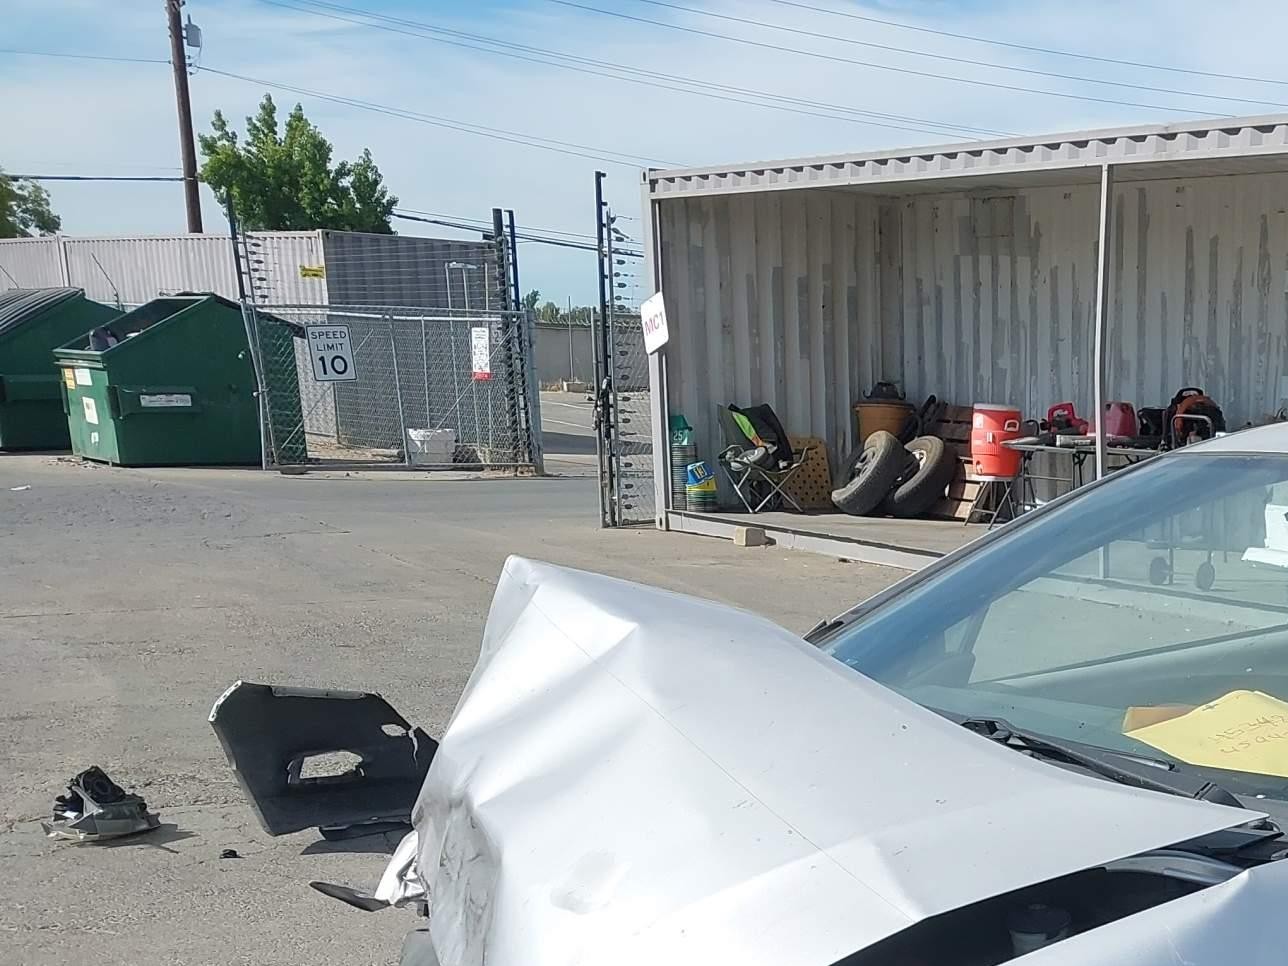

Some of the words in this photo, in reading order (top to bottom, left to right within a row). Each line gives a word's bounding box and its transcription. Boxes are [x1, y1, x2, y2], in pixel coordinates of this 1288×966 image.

[645, 311, 664, 336] MC1
[311, 331, 347, 339] SPEED
[316, 343, 344, 351] LIMIT
[319, 355, 348, 375] 10
